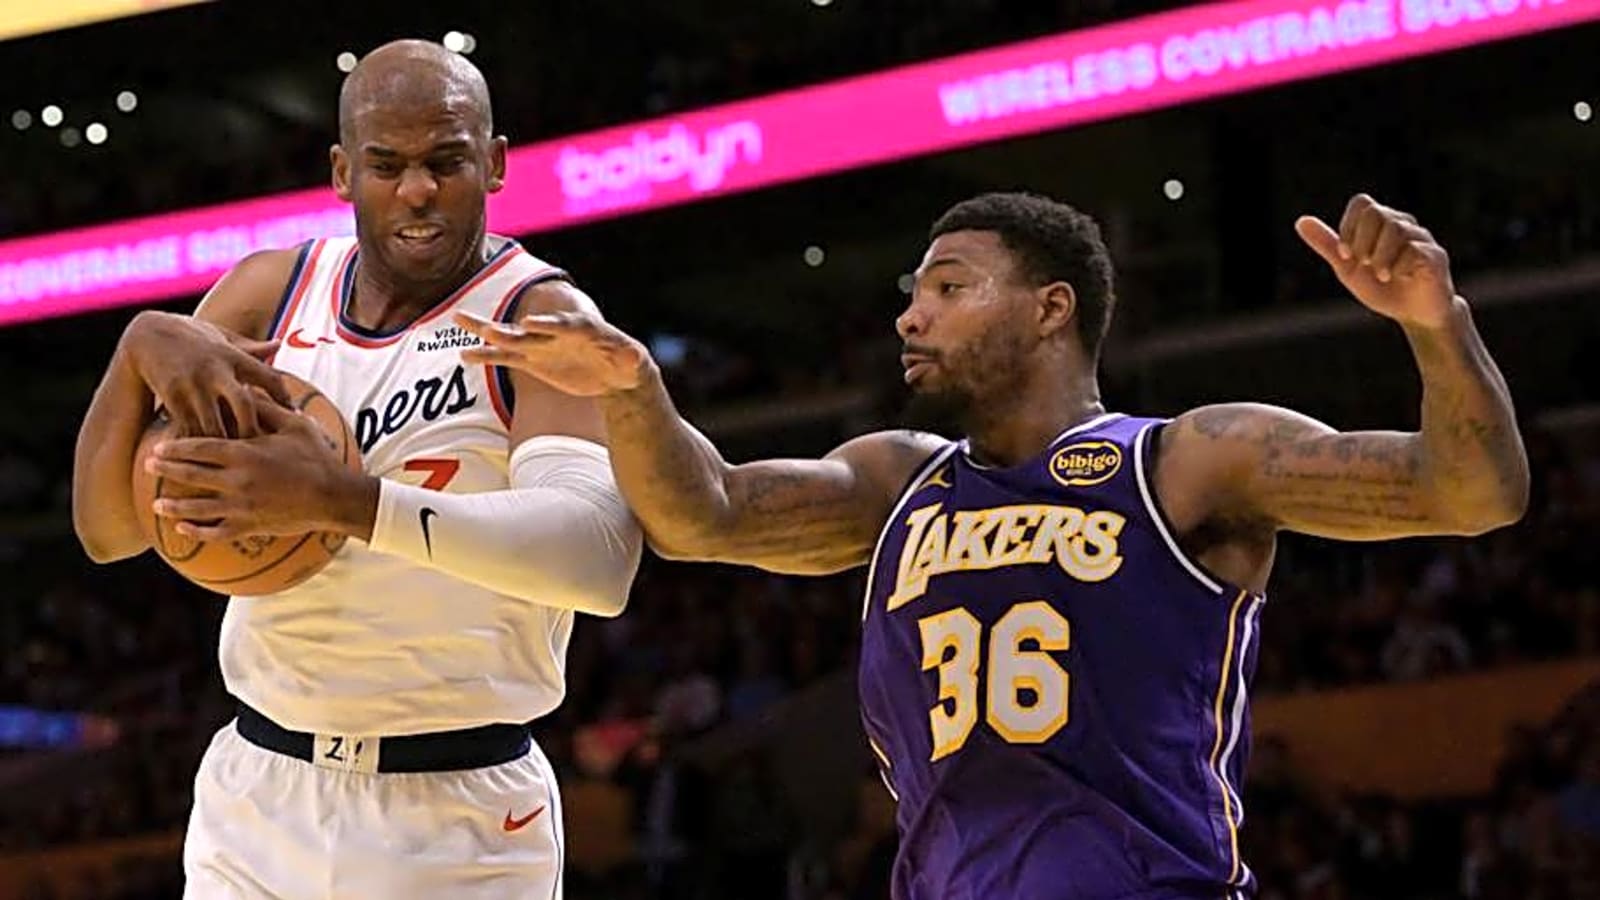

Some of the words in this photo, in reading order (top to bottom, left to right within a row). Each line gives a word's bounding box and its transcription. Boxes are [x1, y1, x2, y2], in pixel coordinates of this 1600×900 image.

[938, 43, 1157, 126] WIRELESS
[1160, 0, 1397, 82] COVERAGE
[554, 122, 763, 198] boldyn
[416, 336, 481, 352] RWANDA
[1056, 453, 1118, 472] bibigo
[886, 502, 1127, 612] LAKERS
[918, 600, 1071, 763] 36
